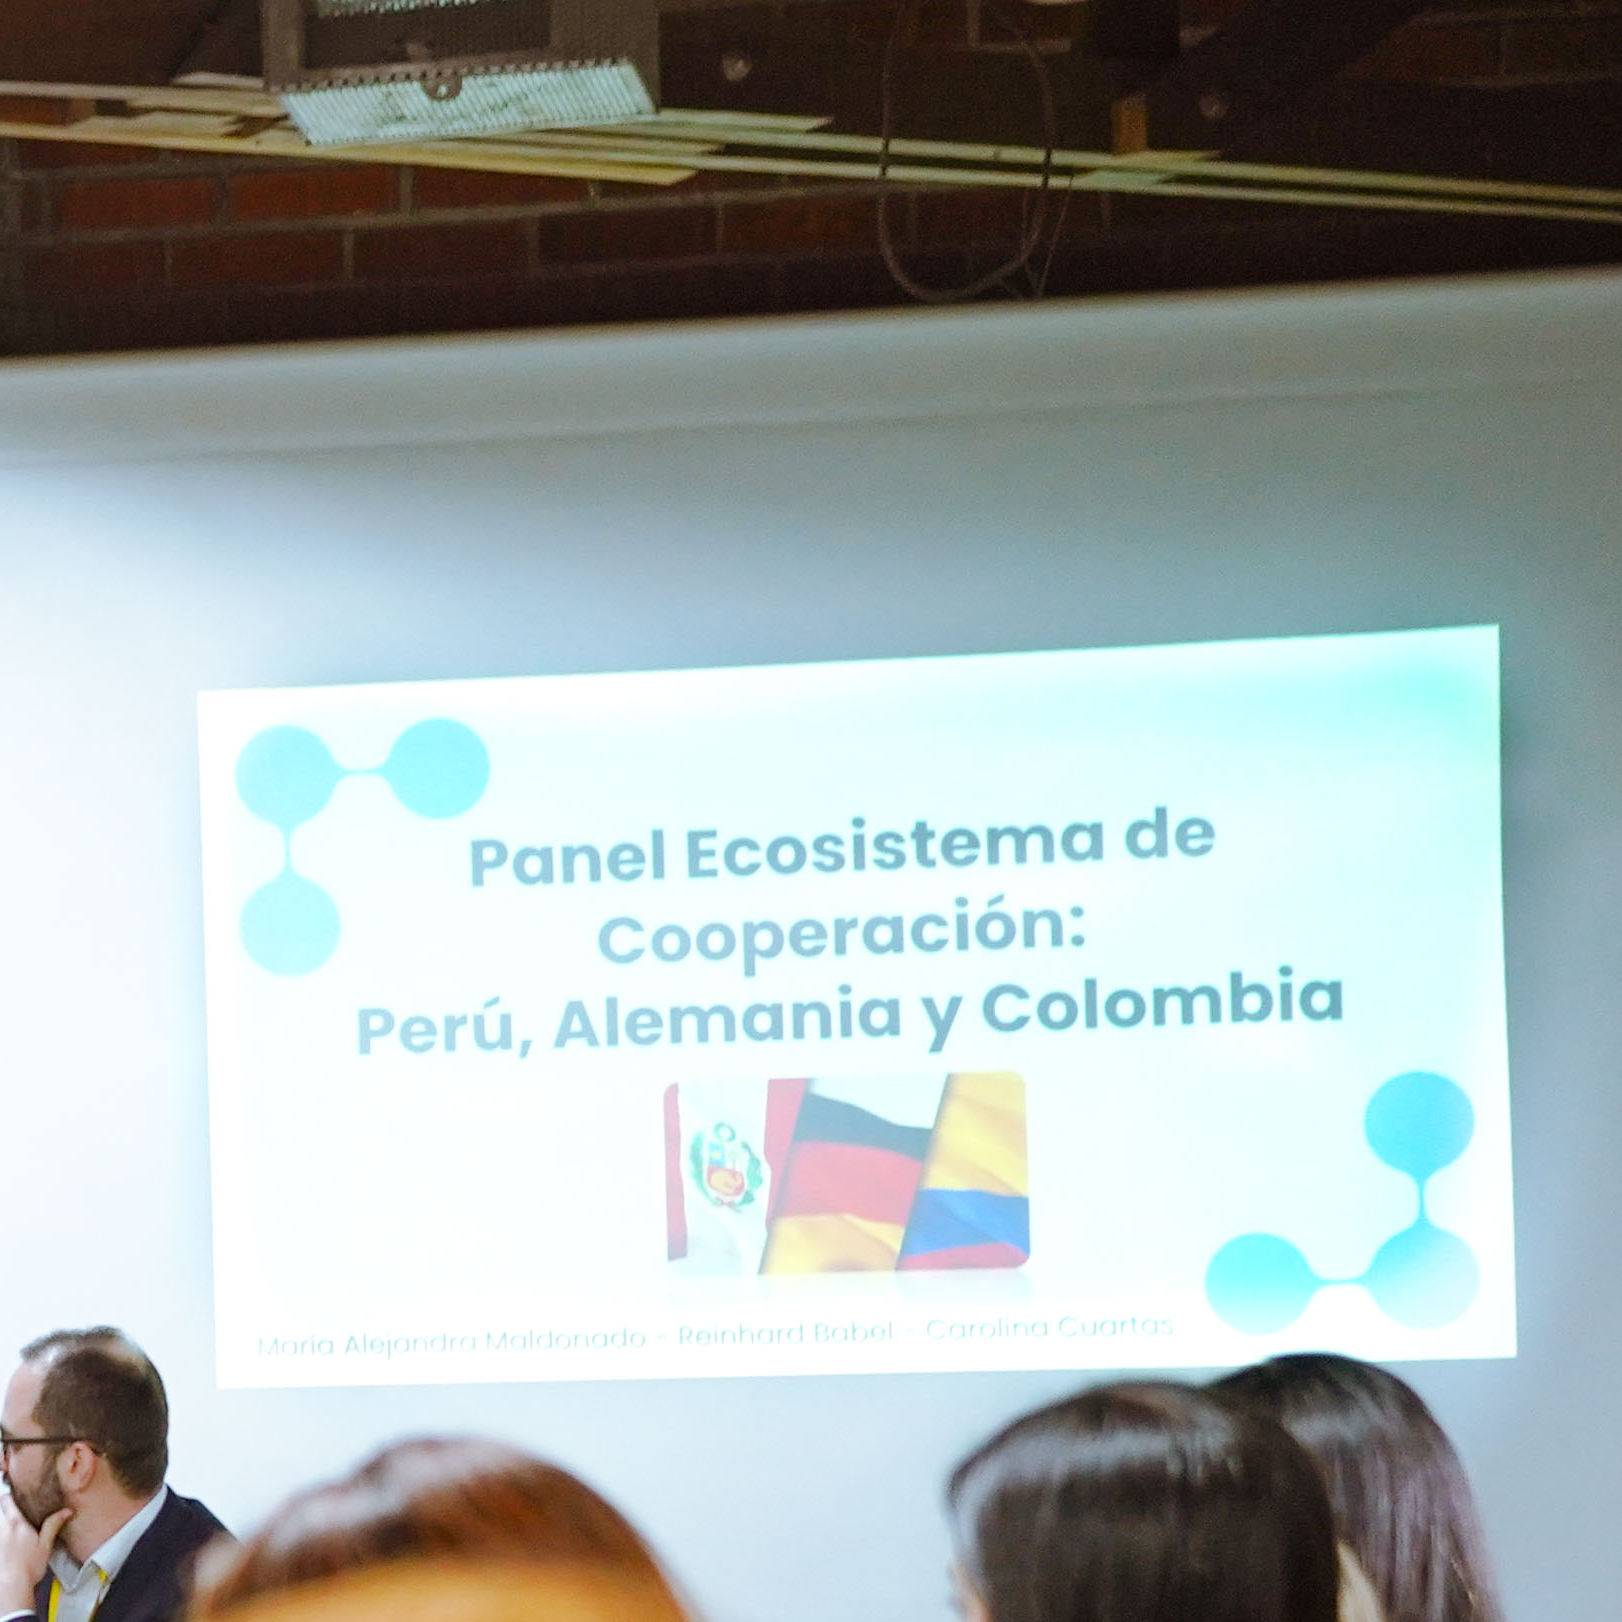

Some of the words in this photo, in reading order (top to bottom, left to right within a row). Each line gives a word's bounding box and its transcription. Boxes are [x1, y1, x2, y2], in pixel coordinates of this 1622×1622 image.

[470, 828, 666, 888] Panel
[686, 815, 1105, 879] Ecosistema
[1124, 805, 1216, 861] de
[596, 896, 1089, 976] Cooperación:
[356, 995, 534, 1060] Perú,
[553, 983, 902, 1049] Alemania
[921, 996, 964, 1055] y
[981, 965, 1346, 1034] Colombia
[344, 1332, 477, 1361] Alejandra
[486, 1327, 647, 1351] Maldonado
[678, 1323, 804, 1347] Reinhard
[814, 1320, 894, 1344] Babel
[926, 1317, 1049, 1341] Carolina
[1058, 1315, 1174, 1338] Cuartas
